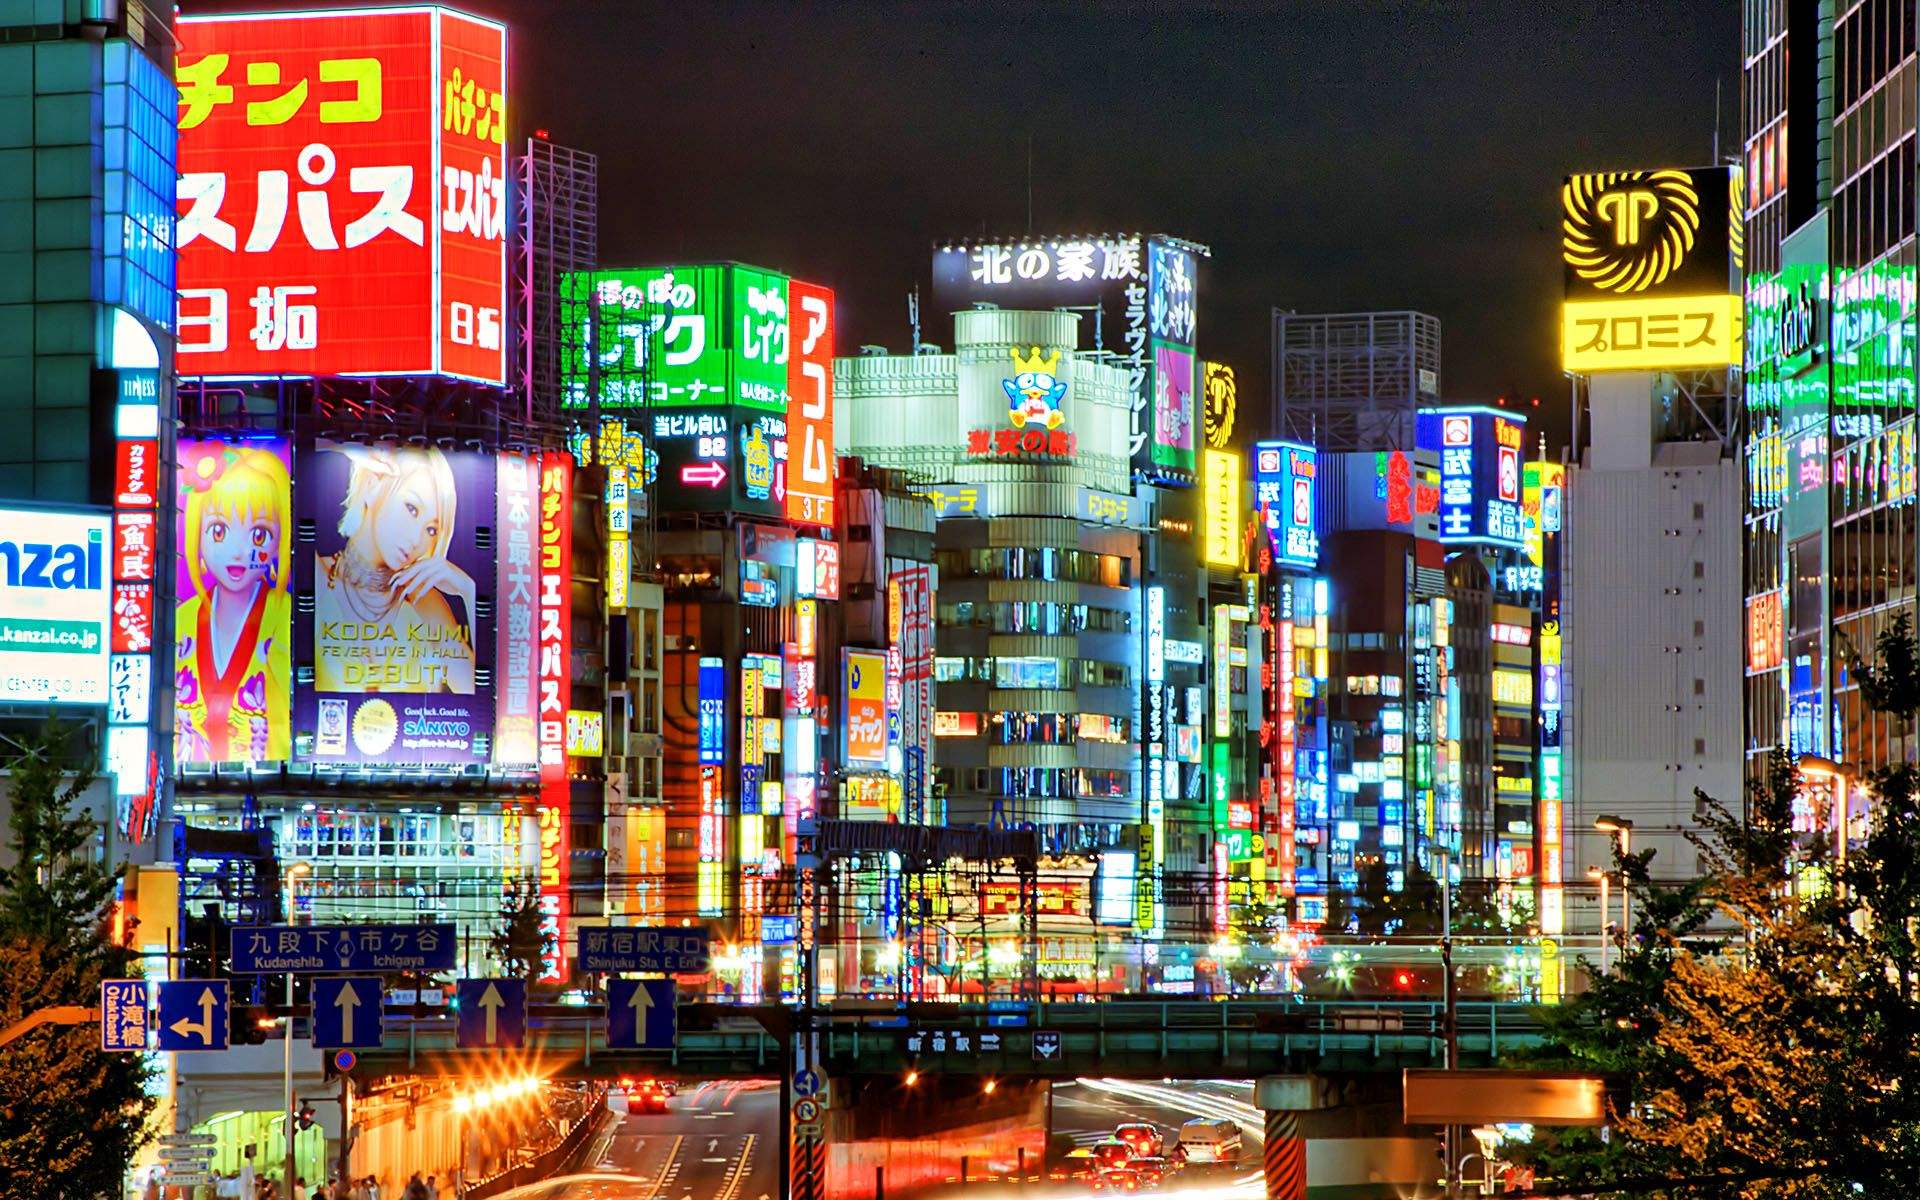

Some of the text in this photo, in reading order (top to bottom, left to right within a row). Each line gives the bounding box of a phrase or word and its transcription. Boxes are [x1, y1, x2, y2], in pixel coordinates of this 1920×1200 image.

[445, 66, 506, 144] パチンコ
[178, 143, 425, 254] スパス
[443, 156, 506, 241] エスパス
[971, 243, 1142, 284] 北の家族
[1575, 312, 1717, 355] プロミス
[801, 295, 828, 484] アコム
[1444, 448, 1472, 534] 武富士
[321, 623, 471, 642] KODA KUMI
[322, 646, 469, 659] FEVER LIVE IN HALL
[343, 663, 449, 686] DEBUT!
[403, 717, 470, 736] SANKYO
[249, 931, 331, 954] 九段下
[586, 931, 700, 954] 新宿駅東口
[254, 956, 324, 969] Kudanshita
[373, 954, 425, 968] Ichigaya
[587, 956, 635, 970] Shinjuku
[121, 984, 146, 1047] 小滝橋
[908, 1036, 970, 1052] 新宿駅
